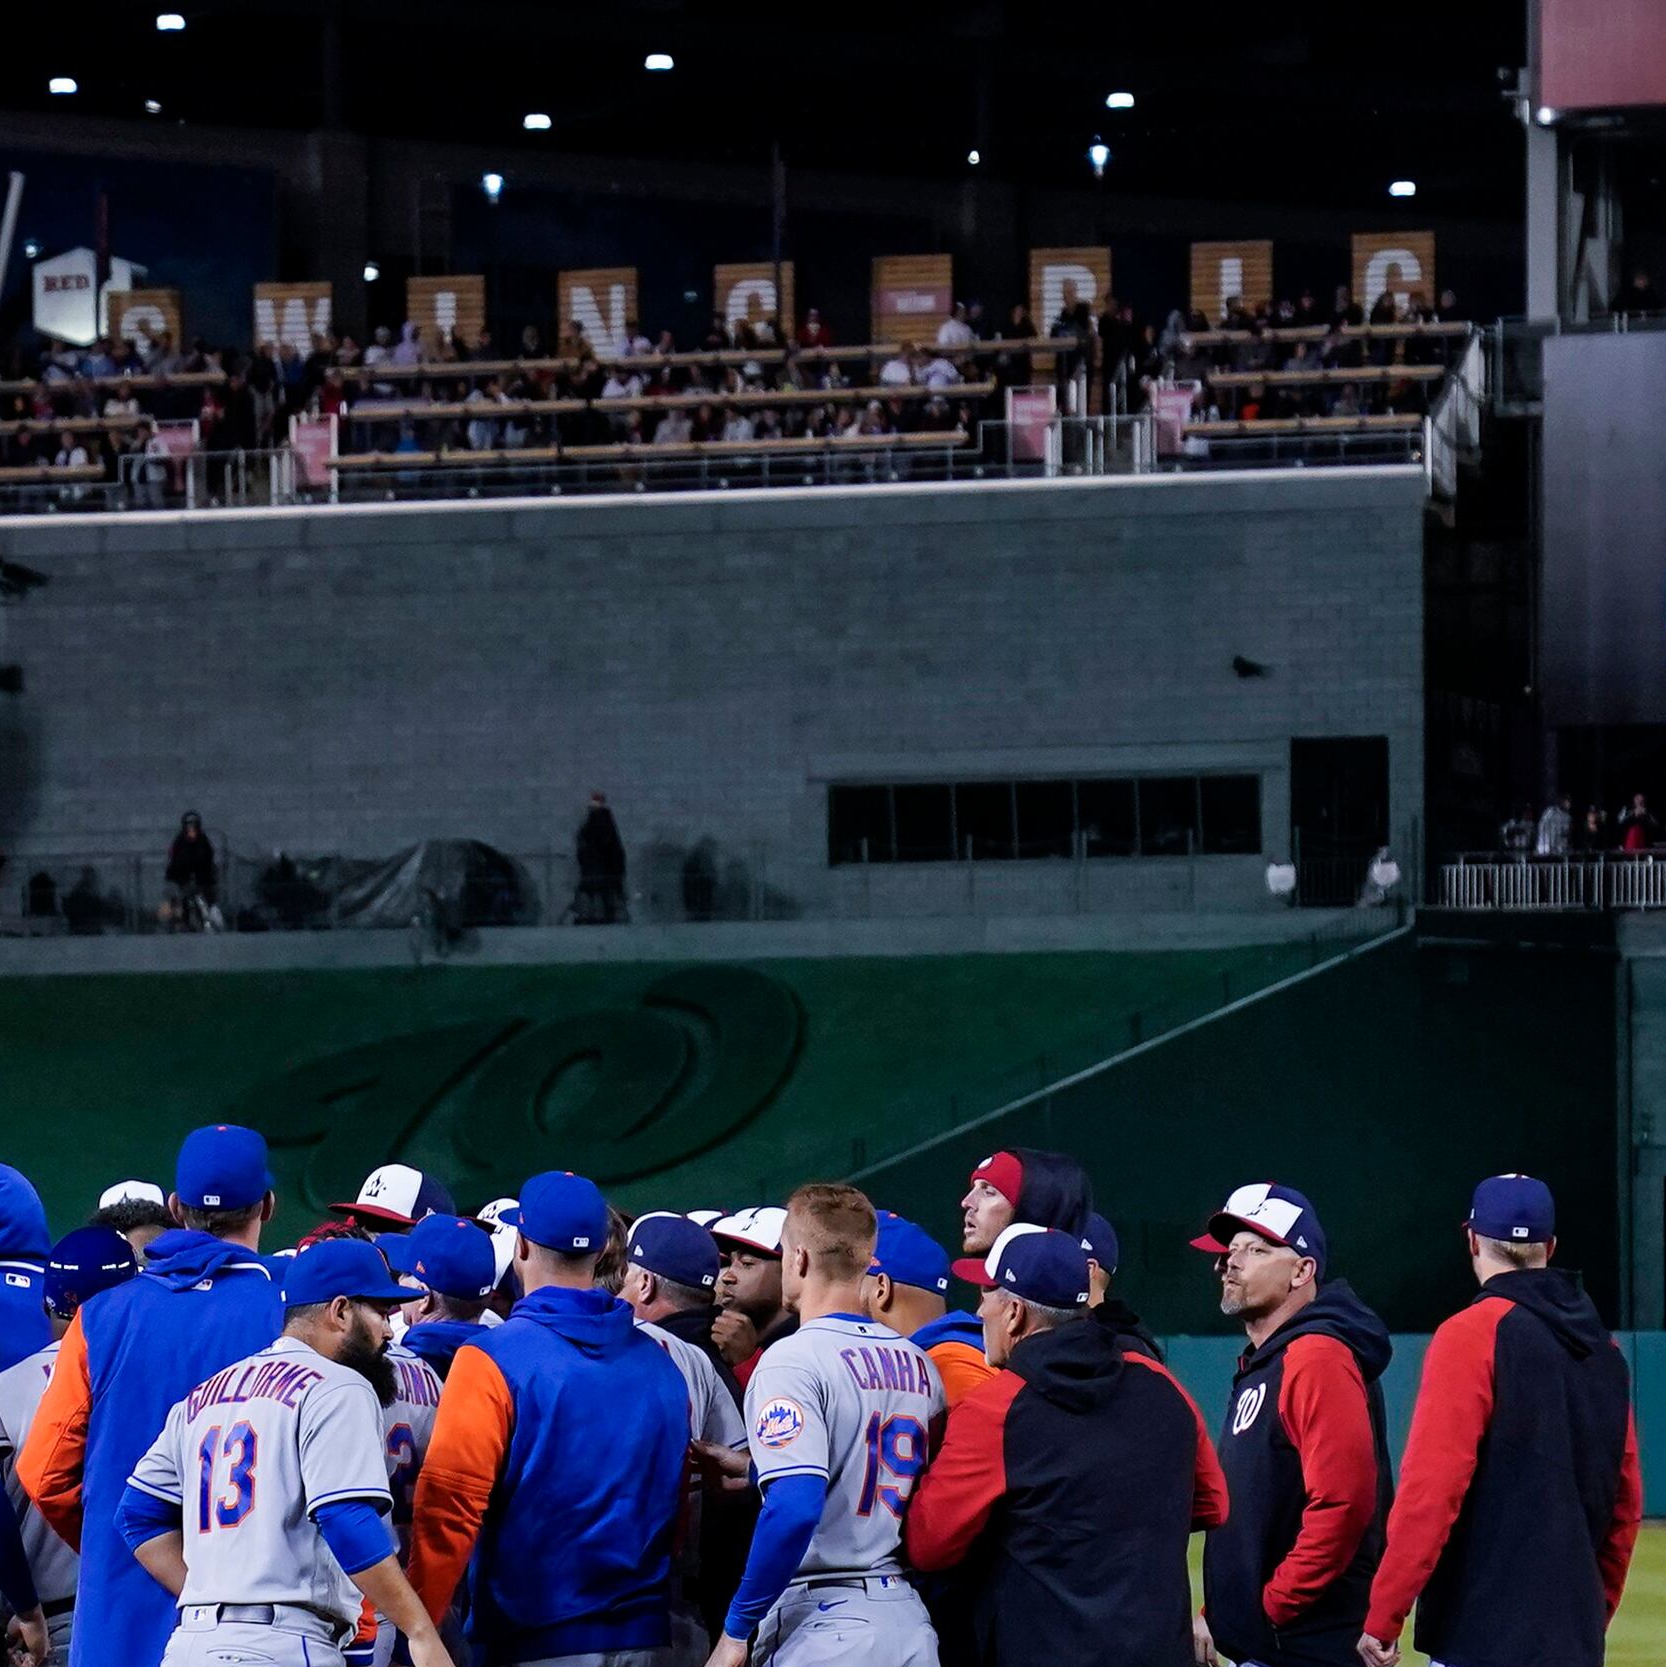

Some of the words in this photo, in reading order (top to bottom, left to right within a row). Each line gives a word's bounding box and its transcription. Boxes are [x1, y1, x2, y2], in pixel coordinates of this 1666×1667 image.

[185, 1360, 326, 1425] GUILLORME
[839, 1346, 932, 1399] CANHA
[1232, 1382, 1267, 1436] W
[198, 1420, 259, 1535] 13
[856, 1410, 931, 1520] 19
